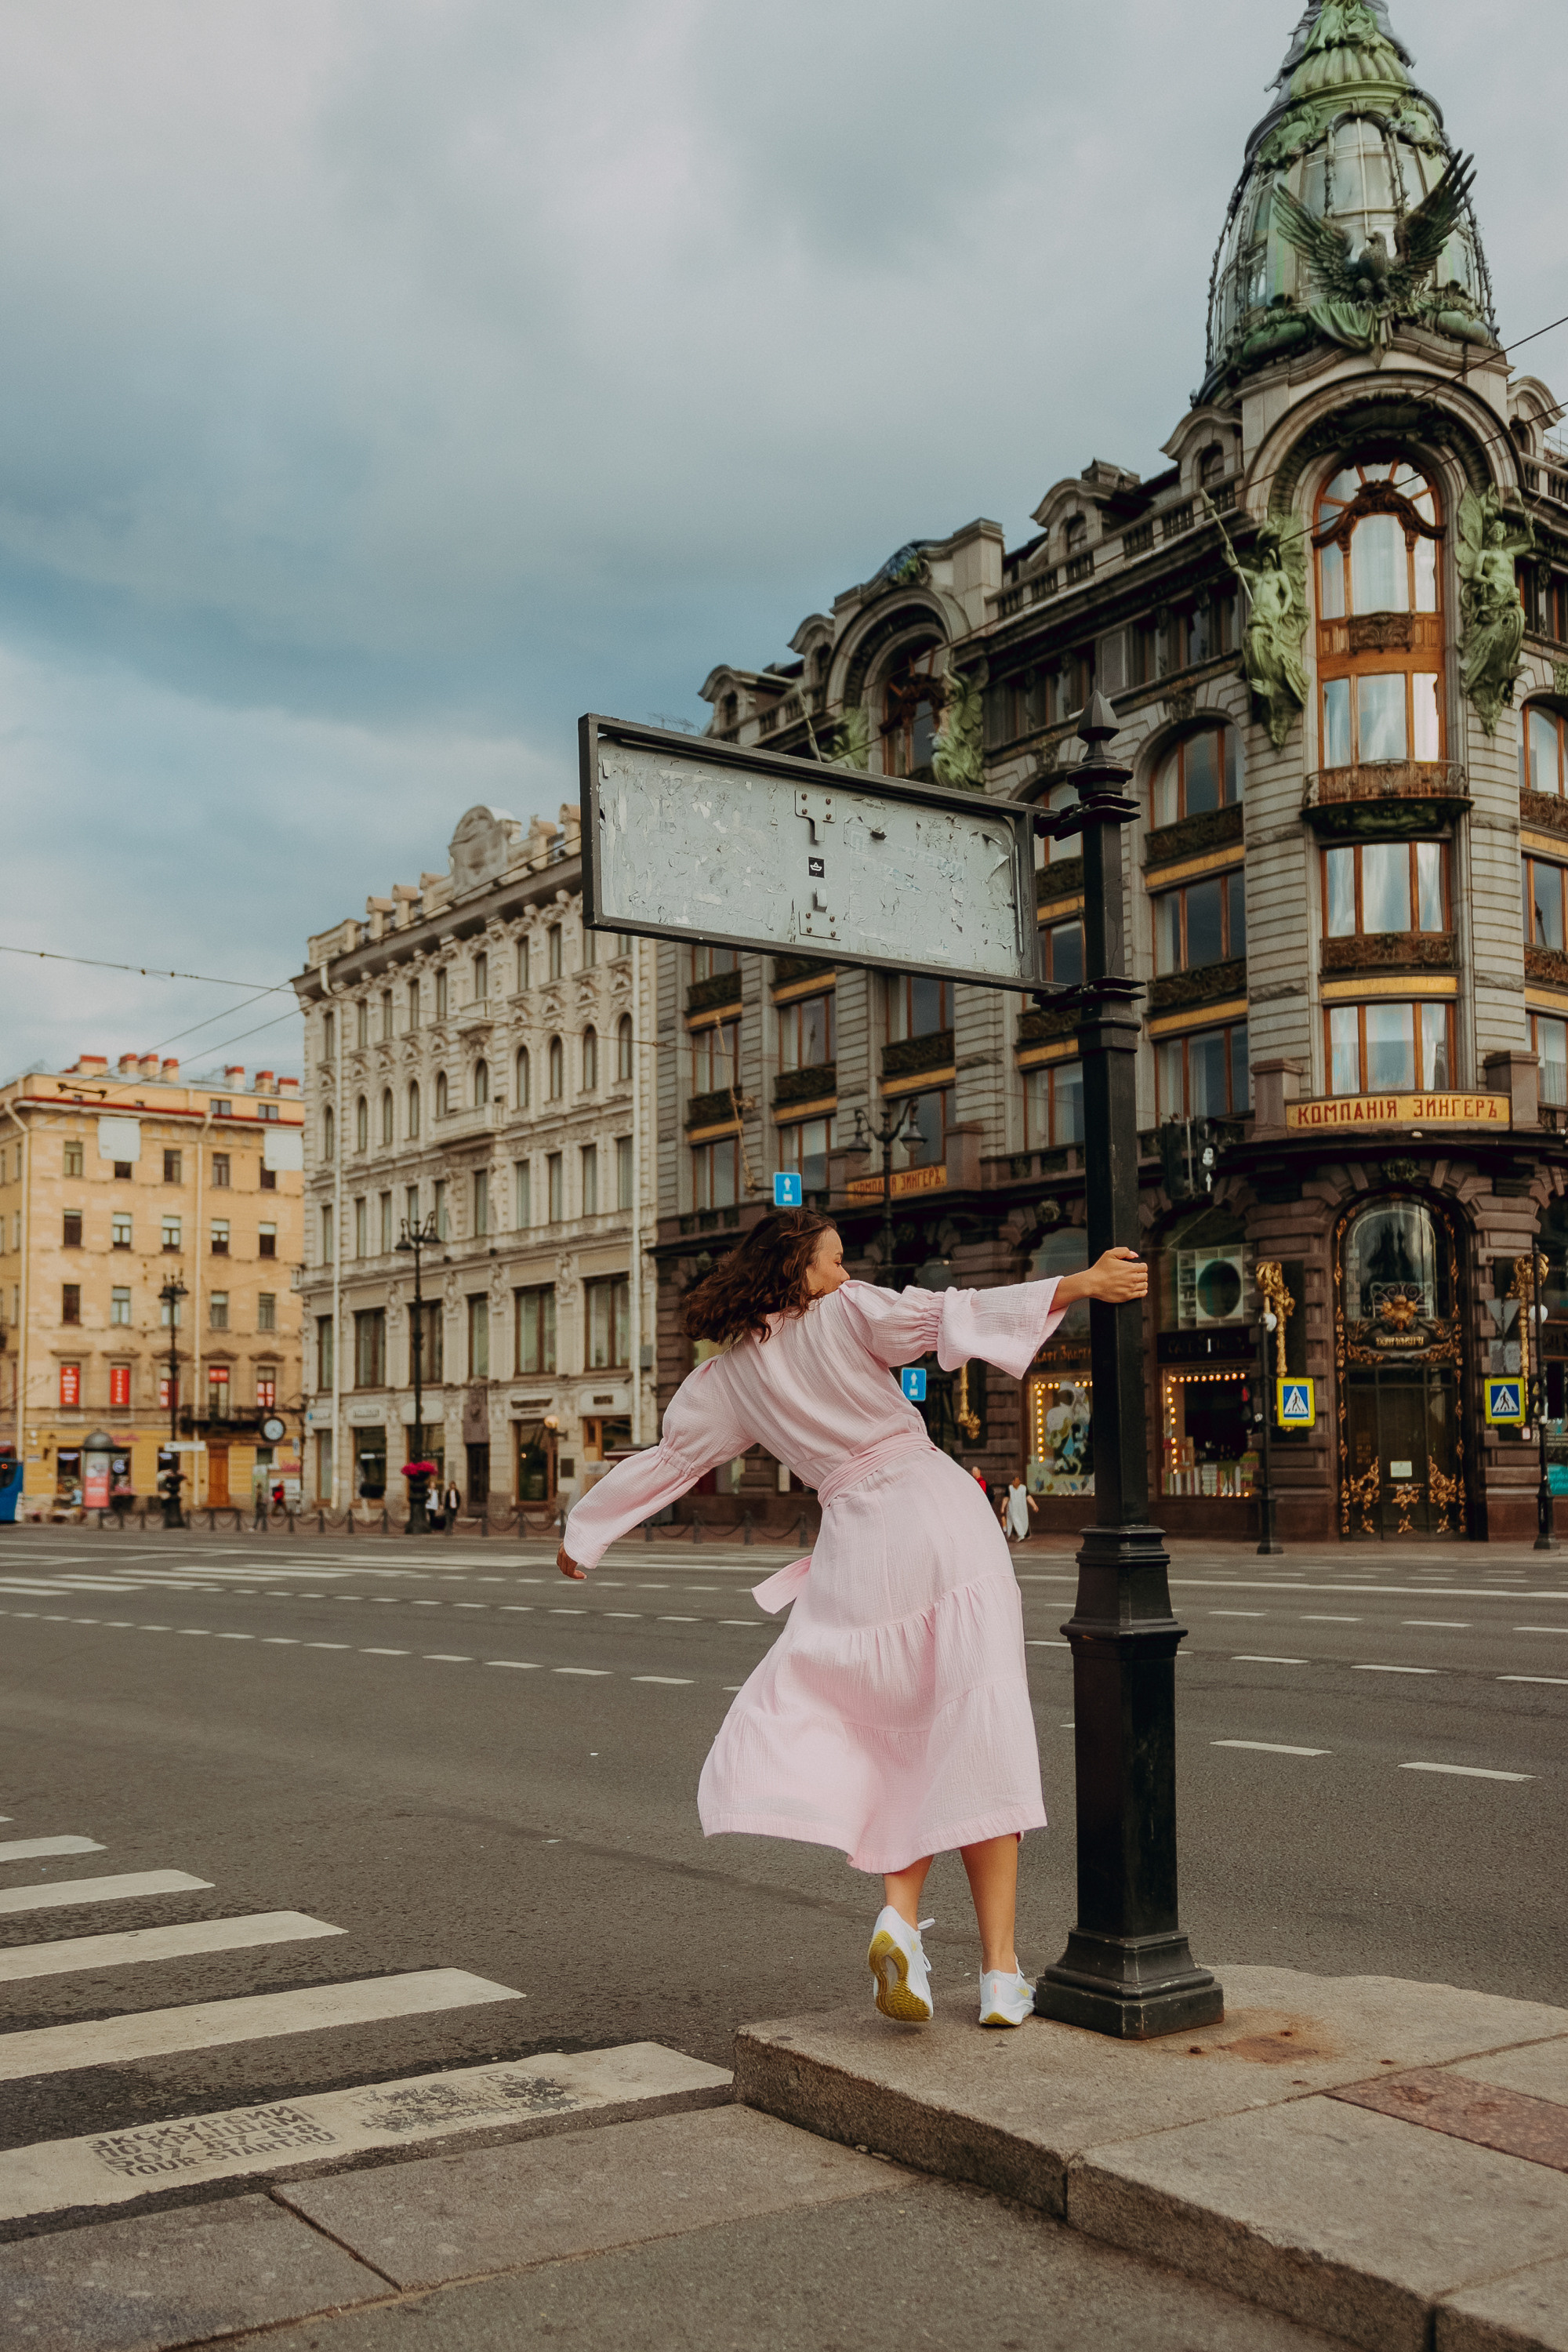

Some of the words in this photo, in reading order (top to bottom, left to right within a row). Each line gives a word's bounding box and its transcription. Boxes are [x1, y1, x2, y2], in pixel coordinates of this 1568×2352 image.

[1298, 1100, 1397, 1125] КОМПАНІЯ
[1414, 1098, 1497, 1118] ЗИНГЕРЪ
[85, 2106, 296, 2149] ЭКСКУРСИИ
[93, 2143, 142, 2159] ПО
[147, 2114, 308, 2151] КРЫШАМ
[115, 2131, 336, 2177] TOUR-START.RU
